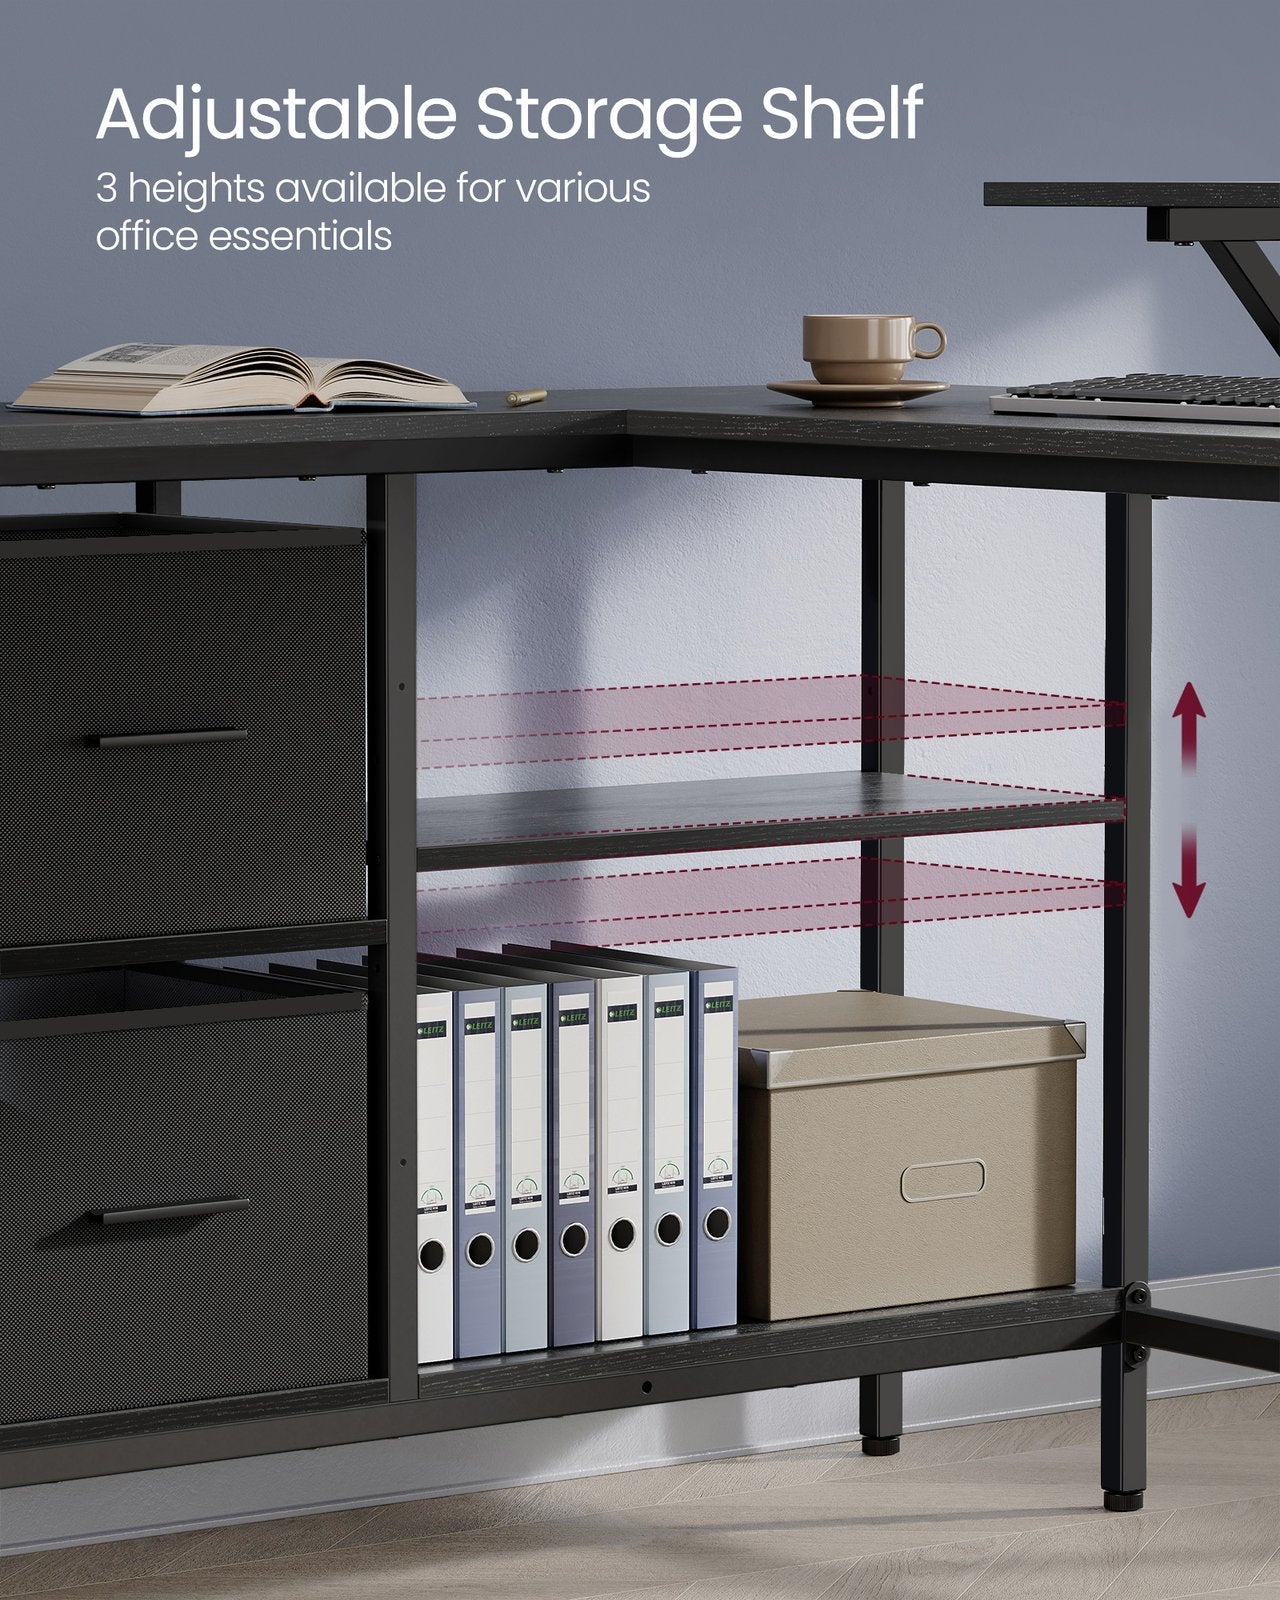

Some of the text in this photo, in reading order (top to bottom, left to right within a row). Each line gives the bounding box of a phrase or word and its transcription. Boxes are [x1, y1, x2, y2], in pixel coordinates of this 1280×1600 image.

[661, 1004, 682, 1013] LEITZ
[710, 999, 731, 1009] LEITZ
[566, 1013, 587, 1022] LEITZ
[614, 1009, 635, 1018] LEITZ
[472, 1021, 493, 1030] LEITZ
[518, 1017, 539, 1026] LEITZ
[423, 1026, 444, 1035] LEITZ
